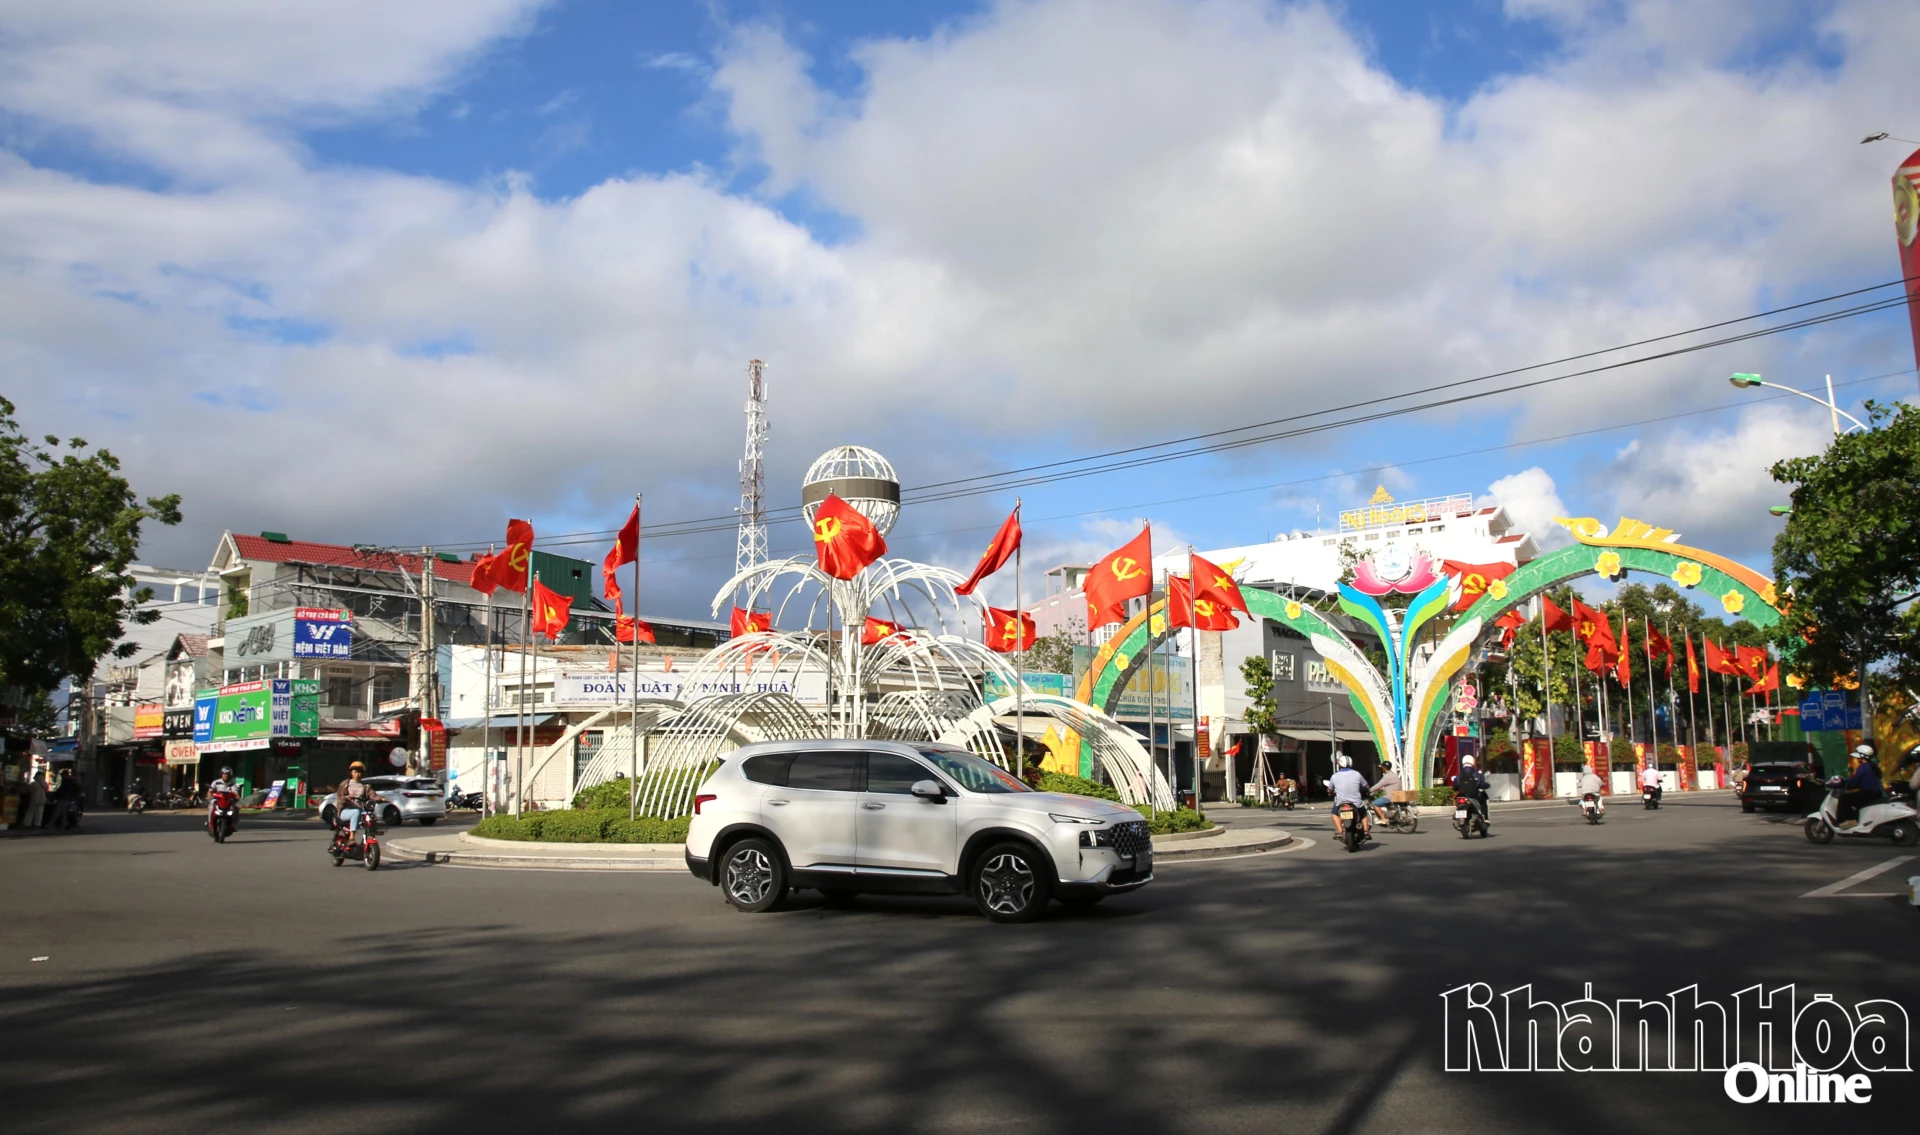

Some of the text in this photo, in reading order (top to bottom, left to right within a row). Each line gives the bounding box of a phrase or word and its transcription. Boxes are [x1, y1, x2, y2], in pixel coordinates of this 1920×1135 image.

[1427, 499, 1469, 514] Hotel
[294, 682, 319, 694] KHO
[583, 680, 626, 694] ĐOÀN
[165, 714, 191, 729] OWEN
[219, 710, 233, 725] KHO
[171, 746, 196, 758] OWEN
